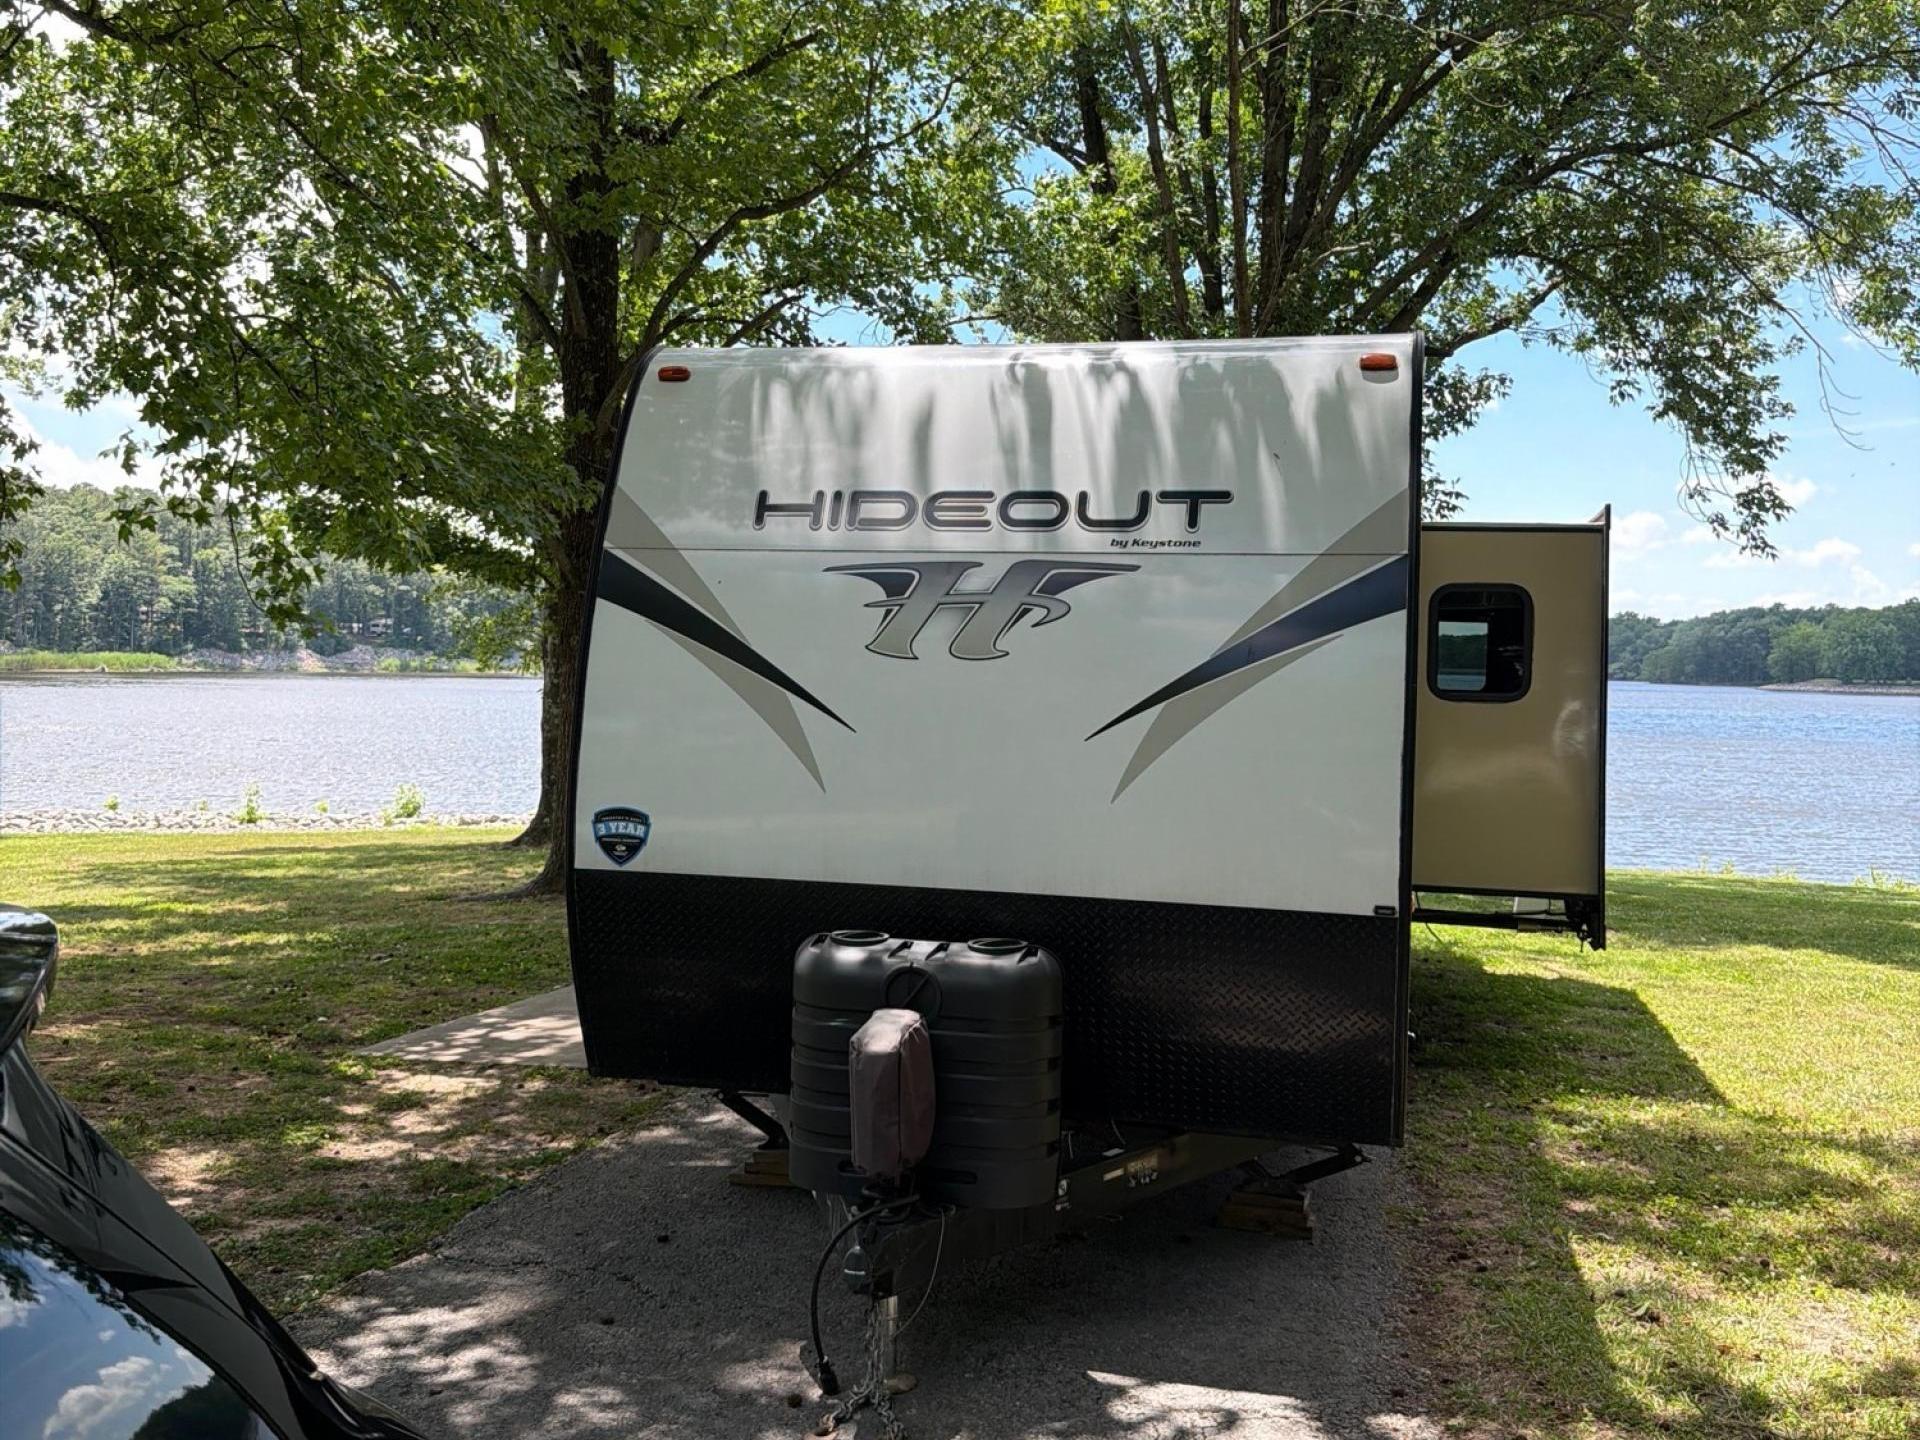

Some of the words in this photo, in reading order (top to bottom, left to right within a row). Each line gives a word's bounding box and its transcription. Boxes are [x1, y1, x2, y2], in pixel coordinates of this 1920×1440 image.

[753, 489, 1234, 533] HIDEOUT
[1110, 538, 1129, 549] by
[1131, 537, 1202, 549] Keystone
[597, 822, 607, 835] 3
[609, 821, 646, 837] YEAR
